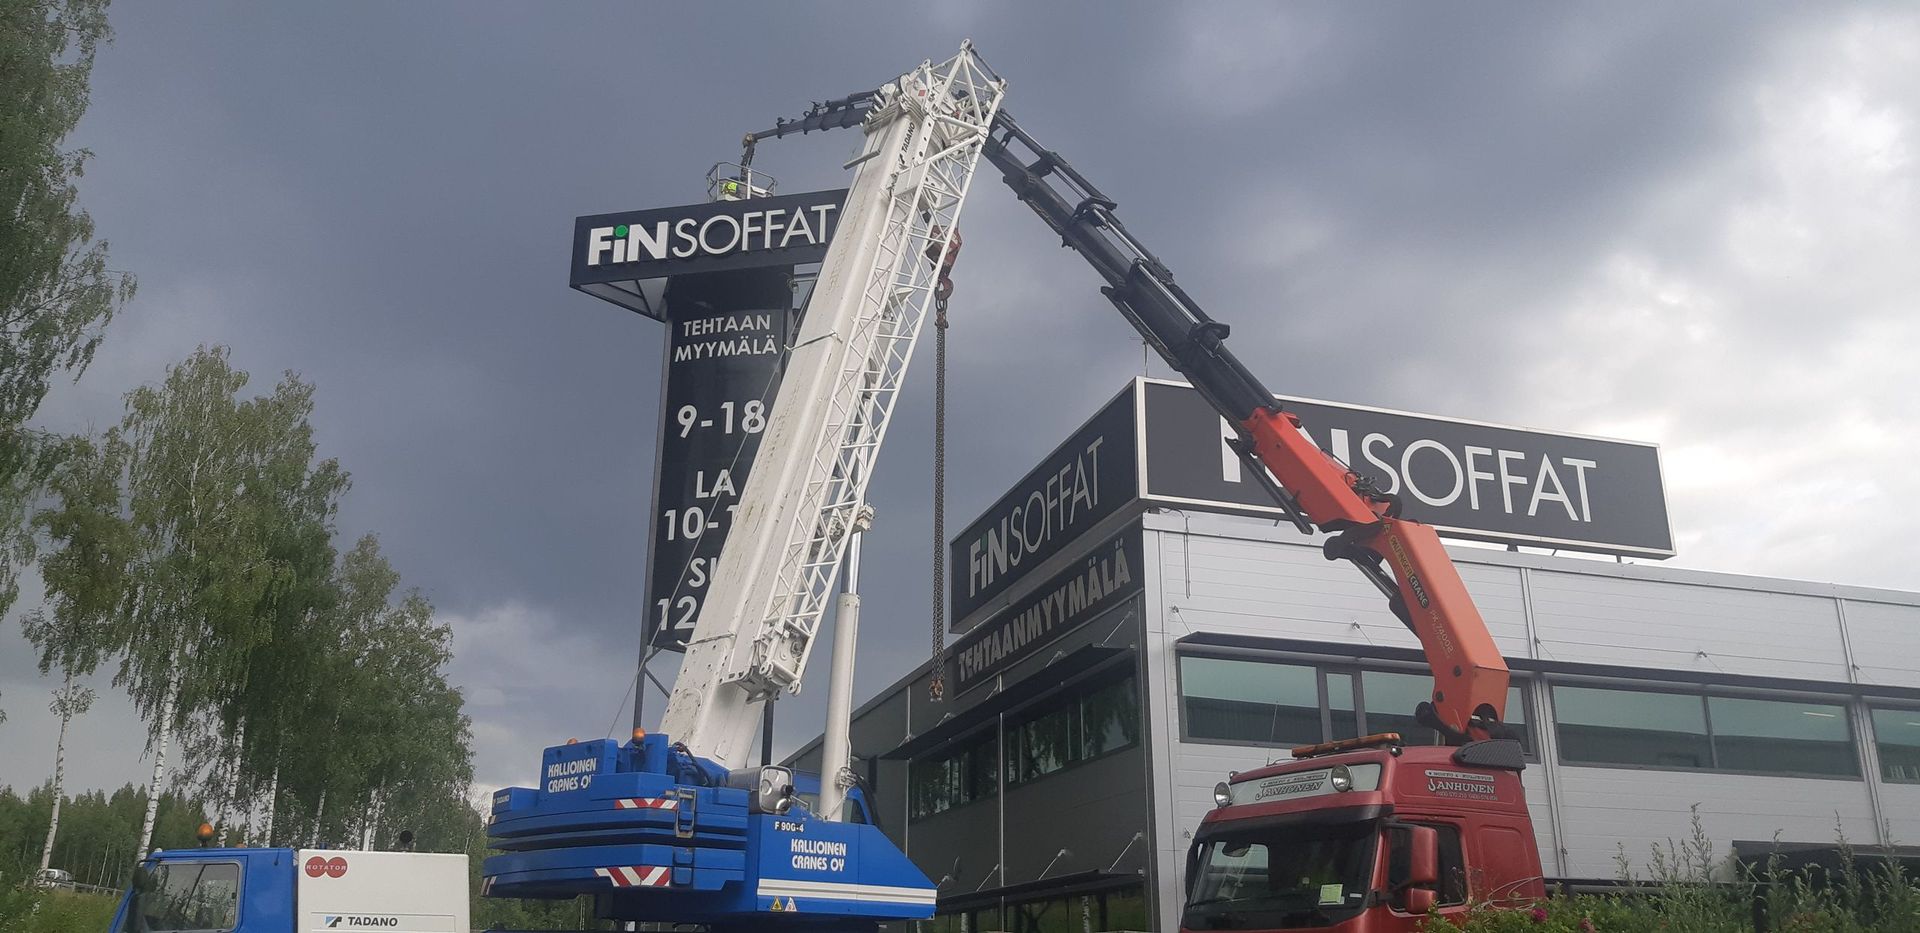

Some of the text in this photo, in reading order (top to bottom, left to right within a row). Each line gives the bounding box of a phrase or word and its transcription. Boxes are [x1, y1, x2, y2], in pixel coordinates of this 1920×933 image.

[901, 122, 916, 153] TADANO
[683, 314, 771, 338] TEHTAAN
[674, 334, 778, 363] MYYMÄLÄ
[677, 399, 766, 439] 9-18
[695, 468, 737, 499] LA
[1409, 574, 1428, 607] CRANE
[958, 537, 1131, 683] TEHTAANMYYMÄLÄ
[548, 757, 597, 778] KALLIOINEN
[548, 777, 579, 794] CRANES
[1428, 778, 1495, 794] JANHUNEN
[774, 821, 804, 833] F 90G-4
[791, 838, 846, 857] KALLIOINEN
[791, 855, 845, 872] CRANES OY
[347, 916, 398, 927] TADANO
